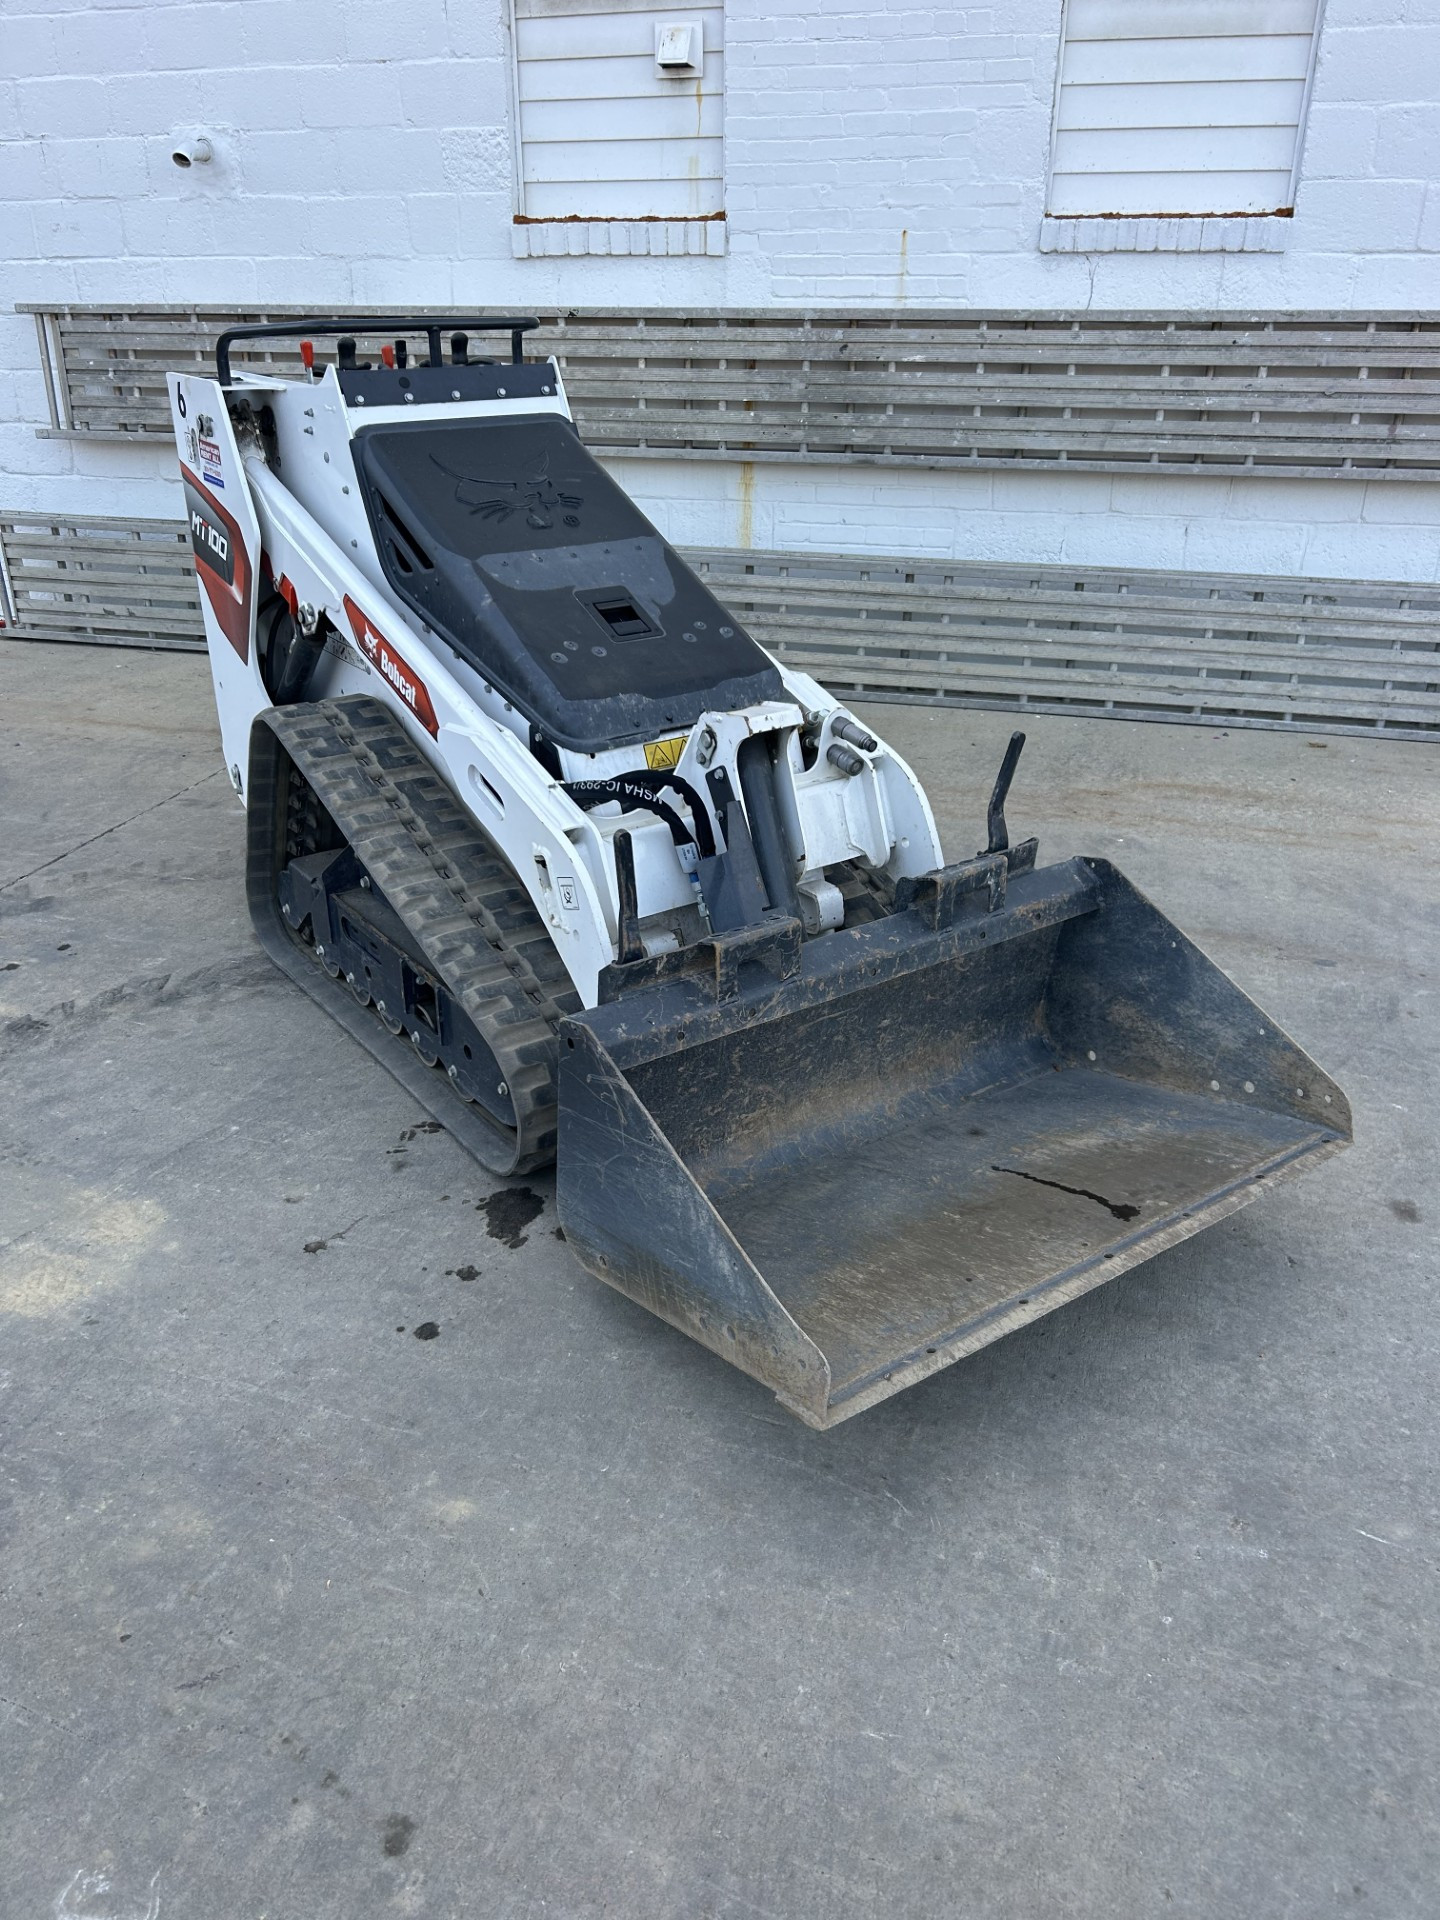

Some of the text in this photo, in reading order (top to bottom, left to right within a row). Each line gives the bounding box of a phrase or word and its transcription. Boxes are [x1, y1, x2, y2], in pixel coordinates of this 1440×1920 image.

[177, 382, 187, 418] 6
[381, 648, 417, 708] Bobcat
[624, 783, 663, 805] MSHA
